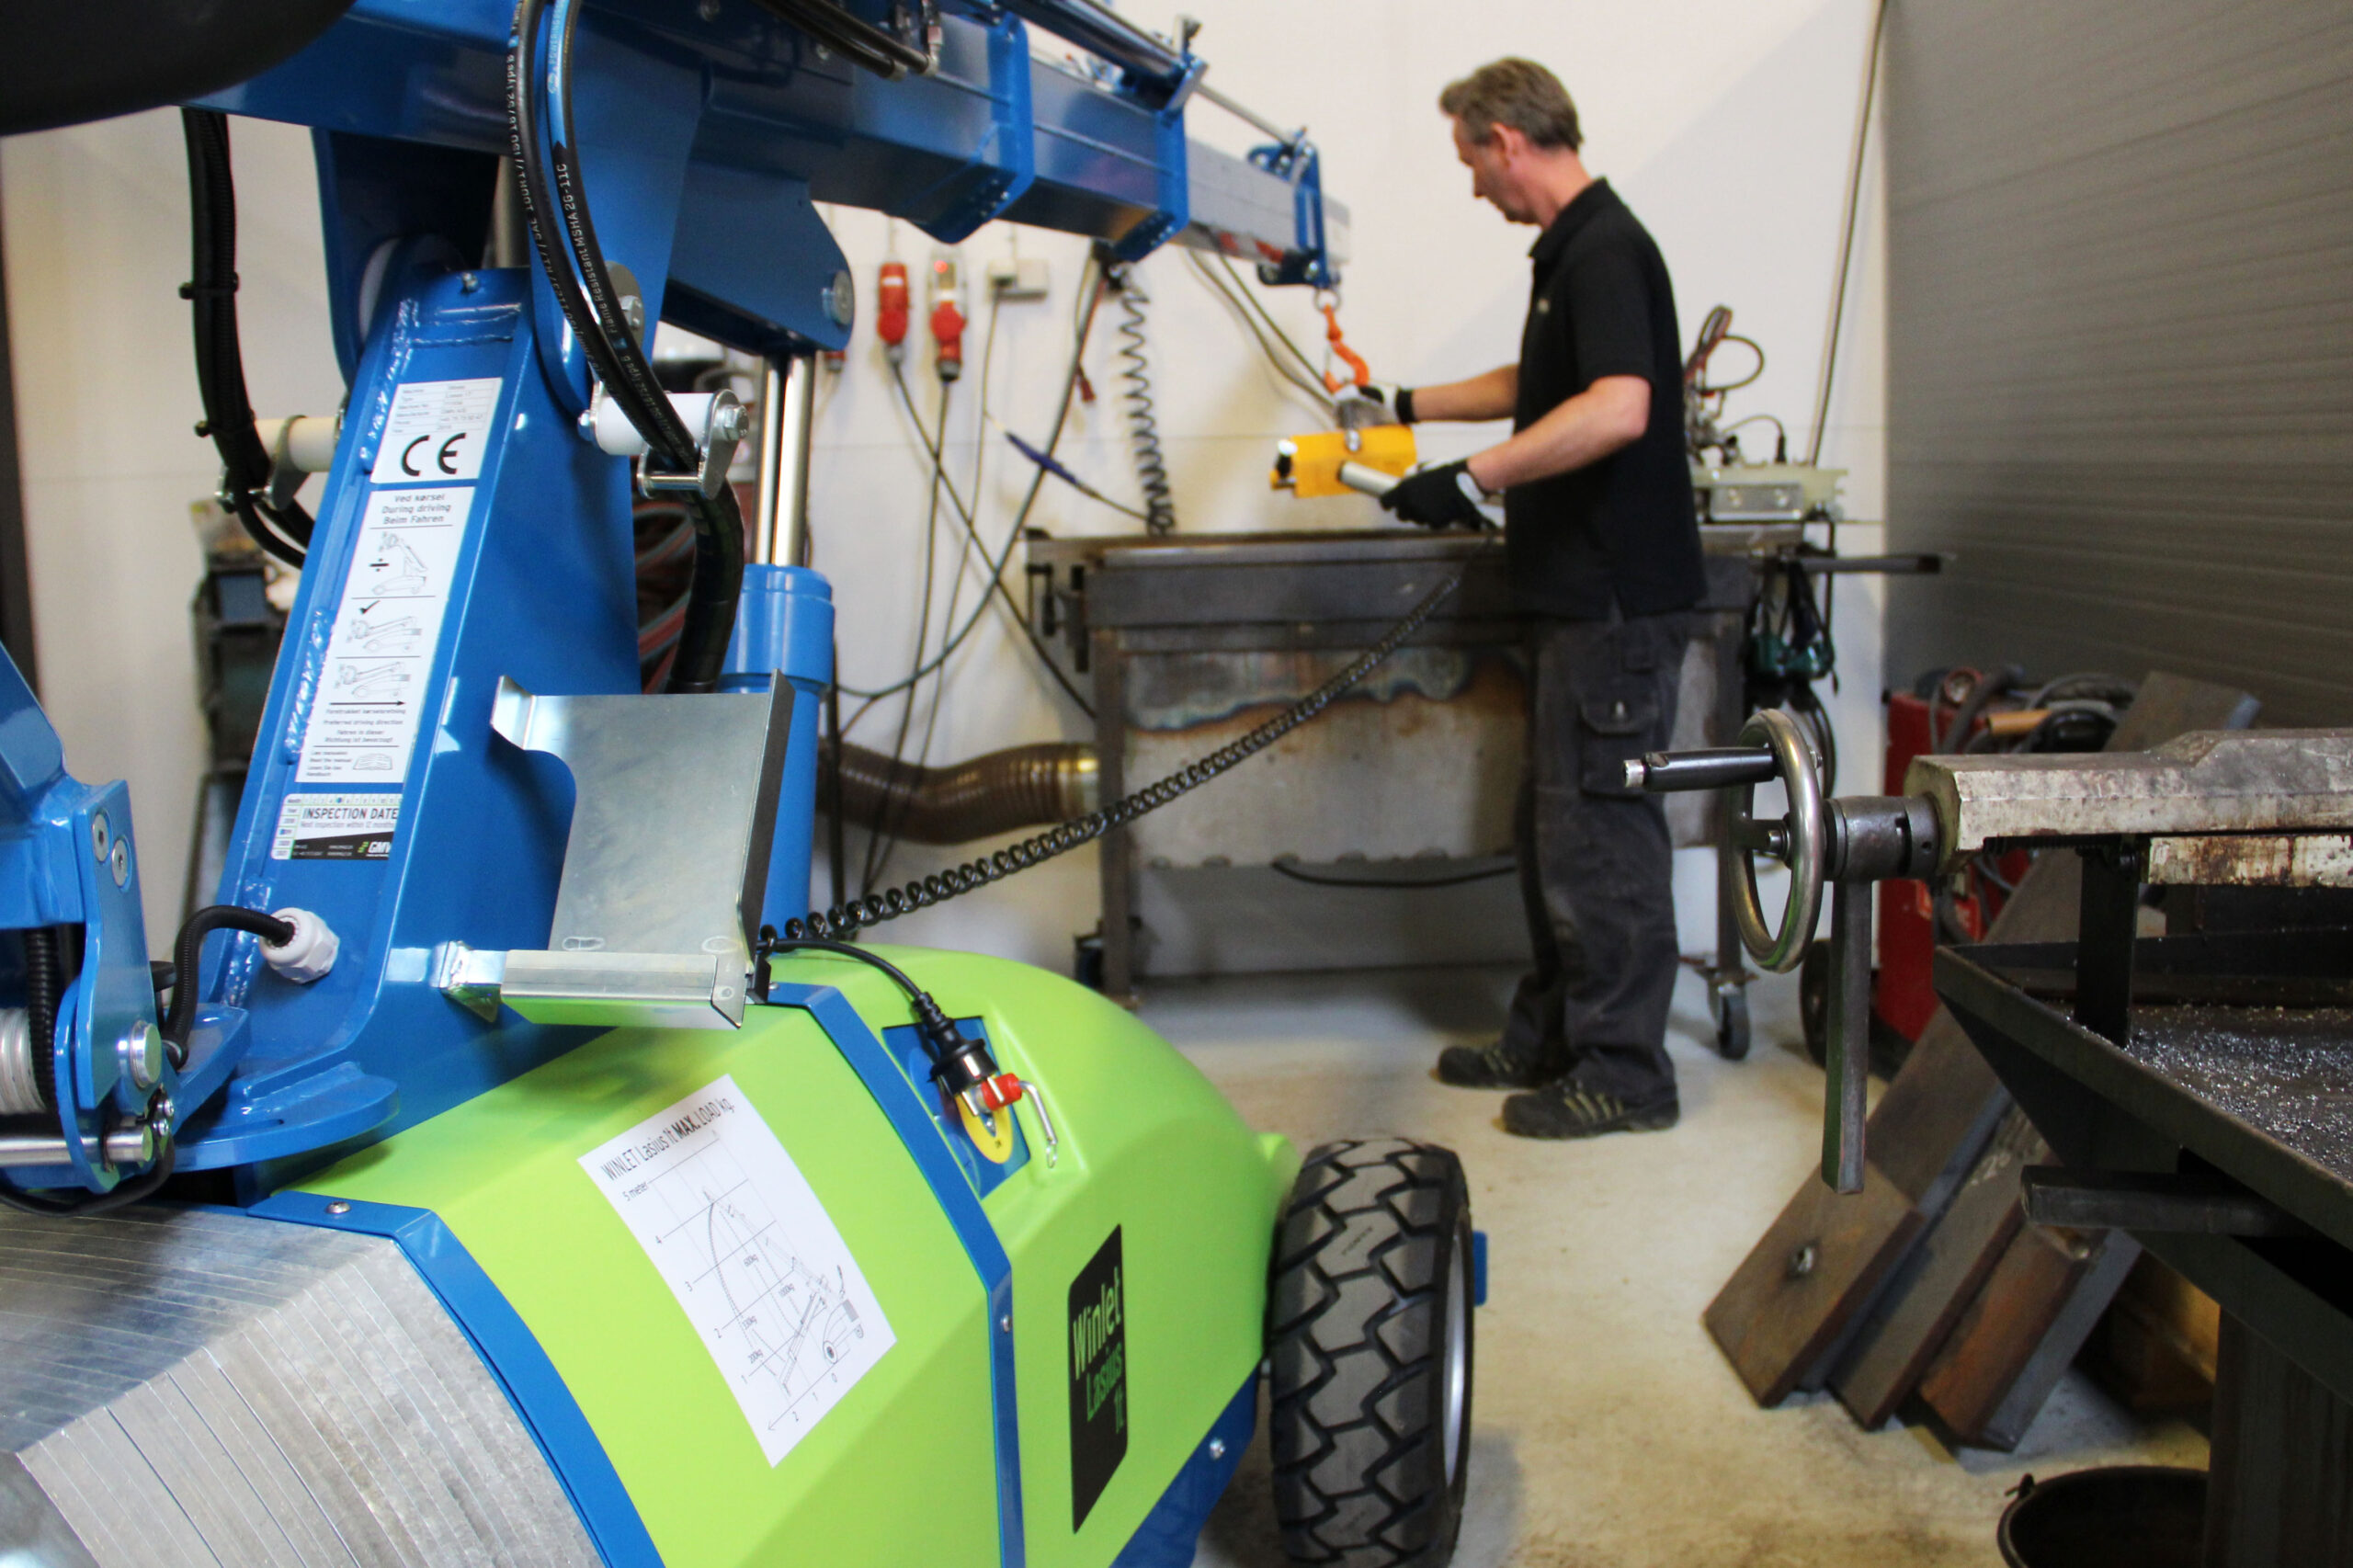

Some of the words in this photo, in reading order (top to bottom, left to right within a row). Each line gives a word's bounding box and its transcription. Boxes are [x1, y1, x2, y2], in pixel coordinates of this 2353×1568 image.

[556, 163, 577, 211] 2G-11C
[567, 211, 586, 248] MSHA
[578, 248, 606, 302] Resistant
[401, 432, 467, 477] CE
[381, 506, 414, 514] During
[416, 504, 451, 513] driving
[410, 515, 445, 524] Fahren
[301, 808, 367, 820] INSPECTION
[370, 808, 398, 820] DATE
[600, 1149, 641, 1181] WINLET
[634, 1135, 669, 1161] Lasius
[670, 1115, 701, 1140] MAX.
[694, 1101, 722, 1126] LOAD
[621, 1190, 631, 1201] 5
[684, 1280, 694, 1292] 3
[713, 1327, 722, 1339] 2
[1073, 1266, 1121, 1381] Winlet
[1086, 1341, 1122, 1423] Lasius
[791, 1410, 800, 1422] 2
